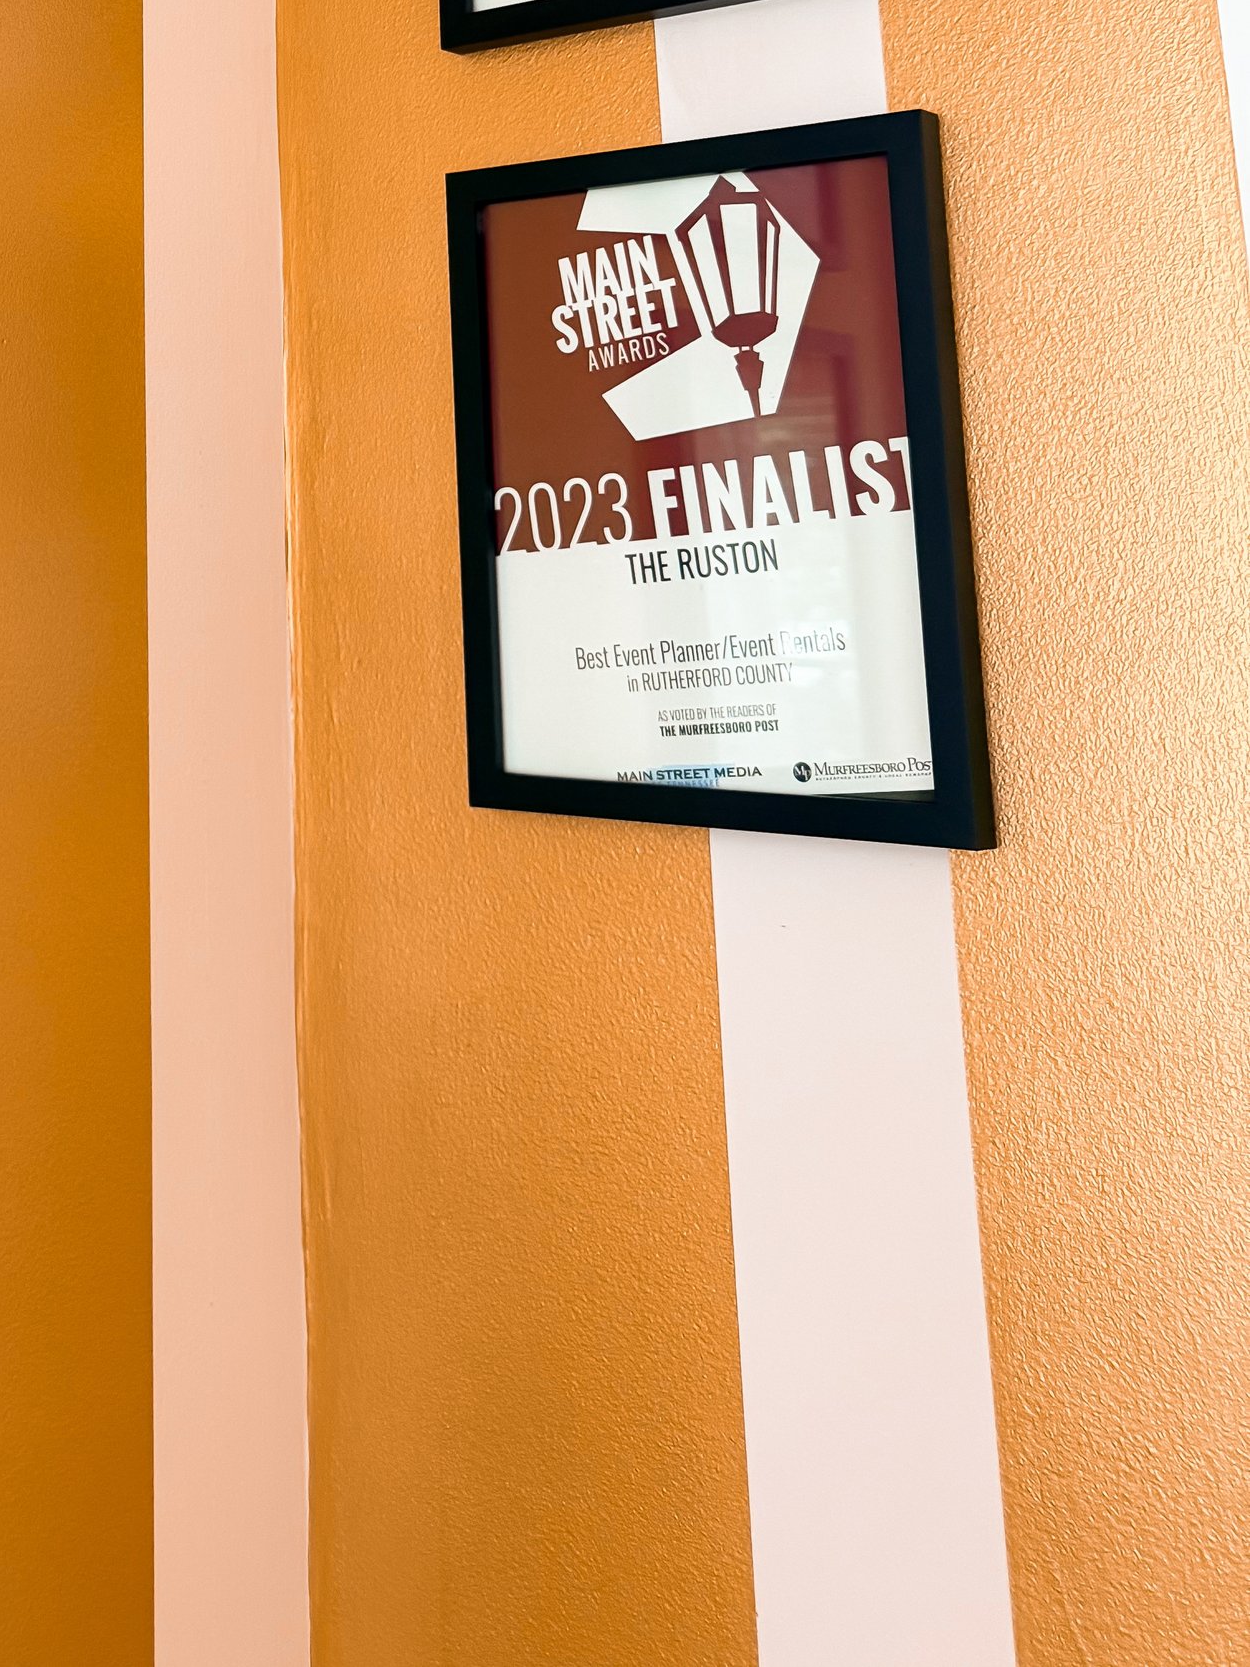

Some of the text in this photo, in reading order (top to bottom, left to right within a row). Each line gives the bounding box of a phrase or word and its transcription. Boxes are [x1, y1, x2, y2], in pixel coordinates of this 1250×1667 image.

[558, 234, 662, 308] MAIN
[551, 277, 679, 354] STREET
[588, 332, 670, 373] AWARDS
[494, 436, 912, 555] 2023 FINALIST
[625, 538, 779, 585] THE RUSTON
[575, 627, 846, 671] Best Event Planner/Event Rentals
[627, 662, 793, 693] in RUTHERFORD COUNTY
[658, 703, 777, 722] AS VOTED BY THE READERS OF
[659, 719, 779, 737] THE MURFREESBORO POST
[617, 766, 763, 782] MAIN STREET MEDIA
[814, 761, 906, 776] MURFREESBORO
